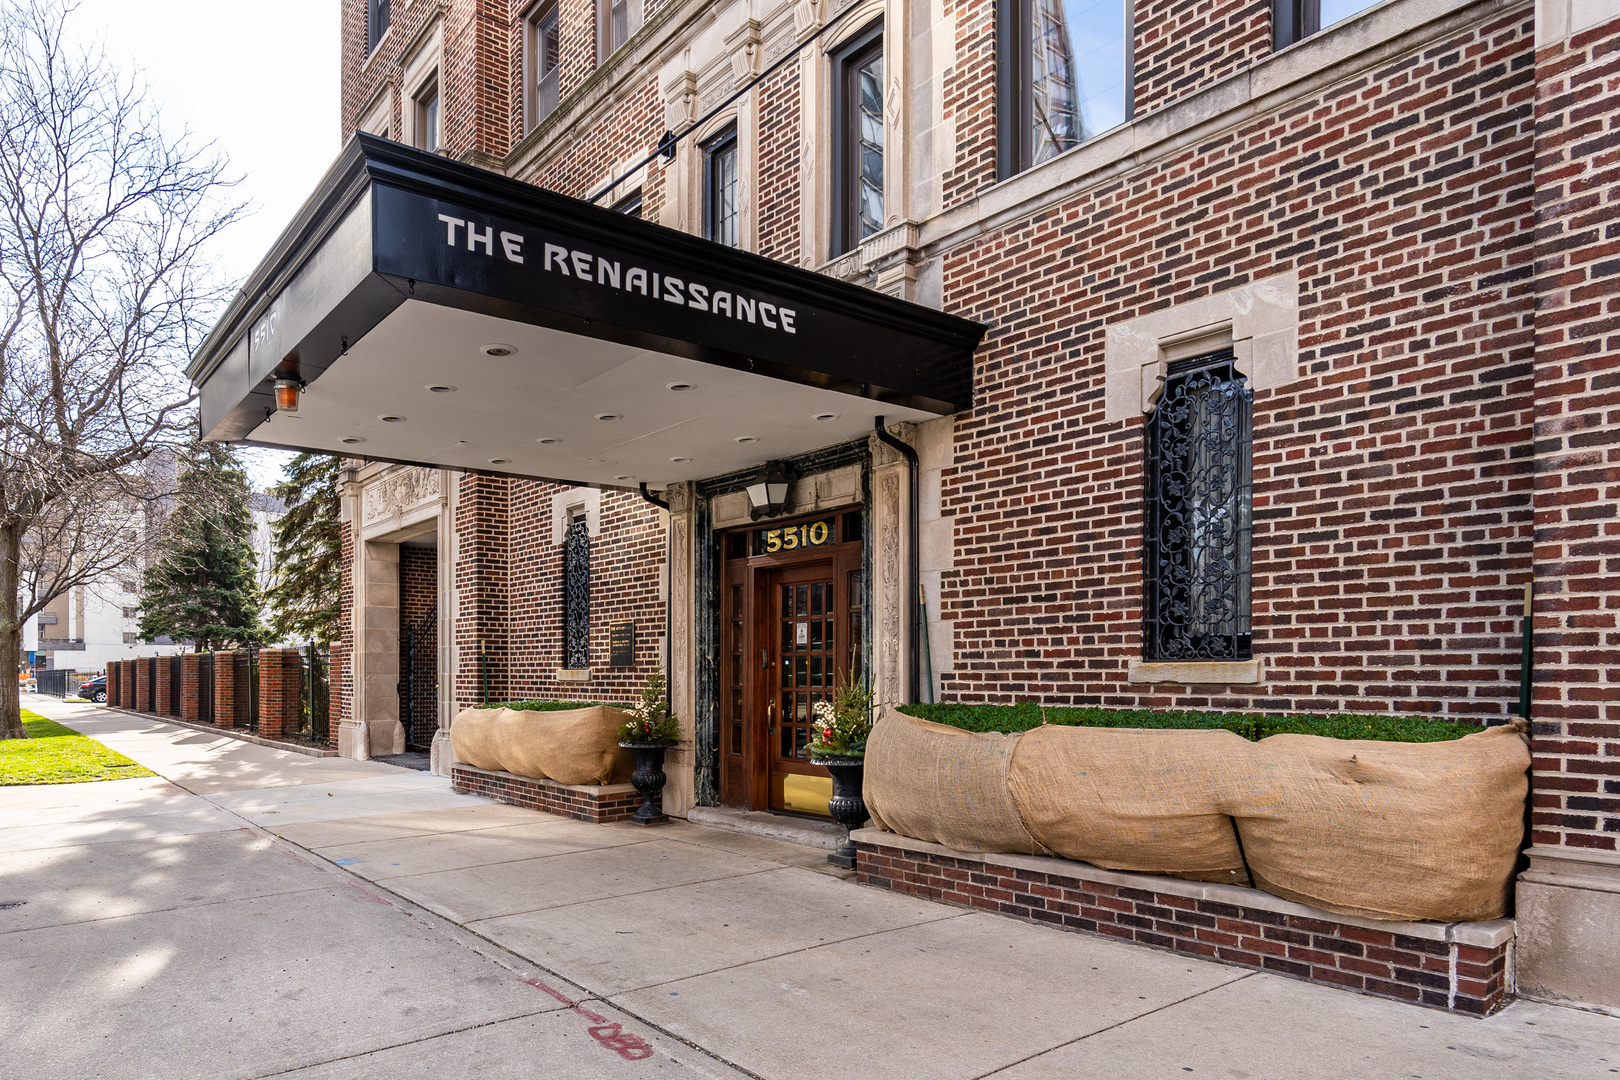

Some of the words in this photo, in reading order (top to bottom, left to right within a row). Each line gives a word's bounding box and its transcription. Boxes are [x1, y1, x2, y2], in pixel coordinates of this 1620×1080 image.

[437, 213, 524, 264] THE
[544, 242, 797, 334] RENAISSANCE
[766, 521, 829, 553] 5510
